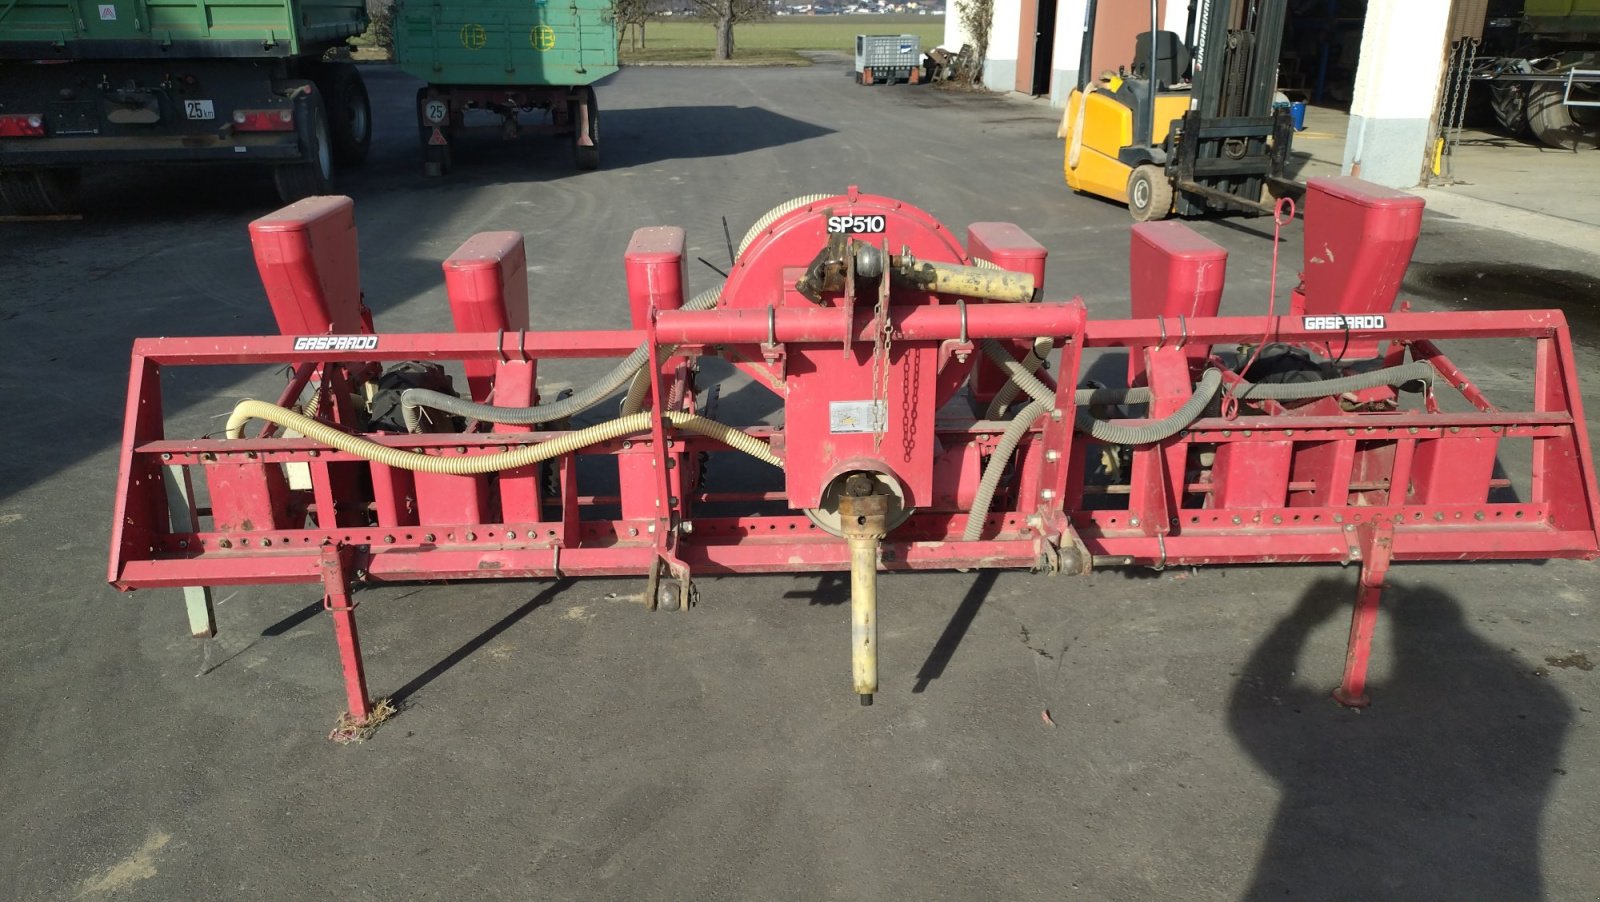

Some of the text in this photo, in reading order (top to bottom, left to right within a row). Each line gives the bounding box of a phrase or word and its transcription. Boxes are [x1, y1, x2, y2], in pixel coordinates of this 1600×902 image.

[188, 103, 202, 118] 25
[430, 105, 442, 118] 25
[828, 216, 884, 232] SP510
[1304, 315, 1384, 330] GASPARDO
[294, 336, 377, 350] GASPARDO
